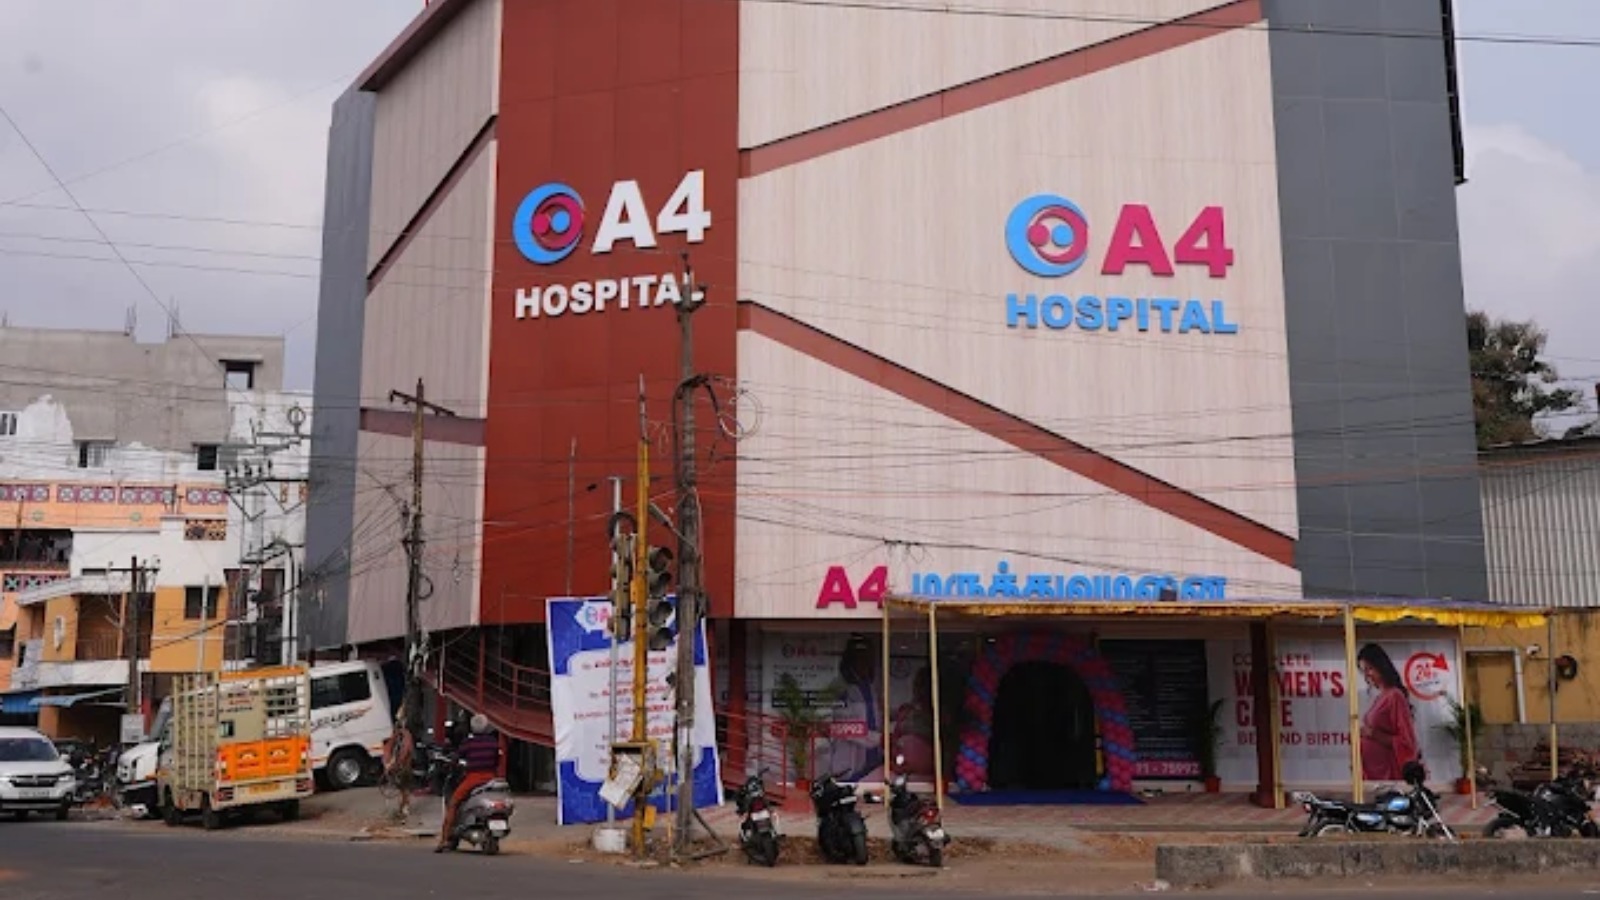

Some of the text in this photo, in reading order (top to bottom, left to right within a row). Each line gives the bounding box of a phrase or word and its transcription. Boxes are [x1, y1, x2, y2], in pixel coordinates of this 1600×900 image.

[591, 169, 712, 254] A4
[1101, 203, 1234, 278] A4
[1005, 293, 1238, 334] HOSPITAL
[815, 565, 889, 609] A4
[1234, 670, 1345, 698] WMEN'S
[1236, 699, 1293, 728] CE
[1306, 732, 1351, 745] BIRTH
